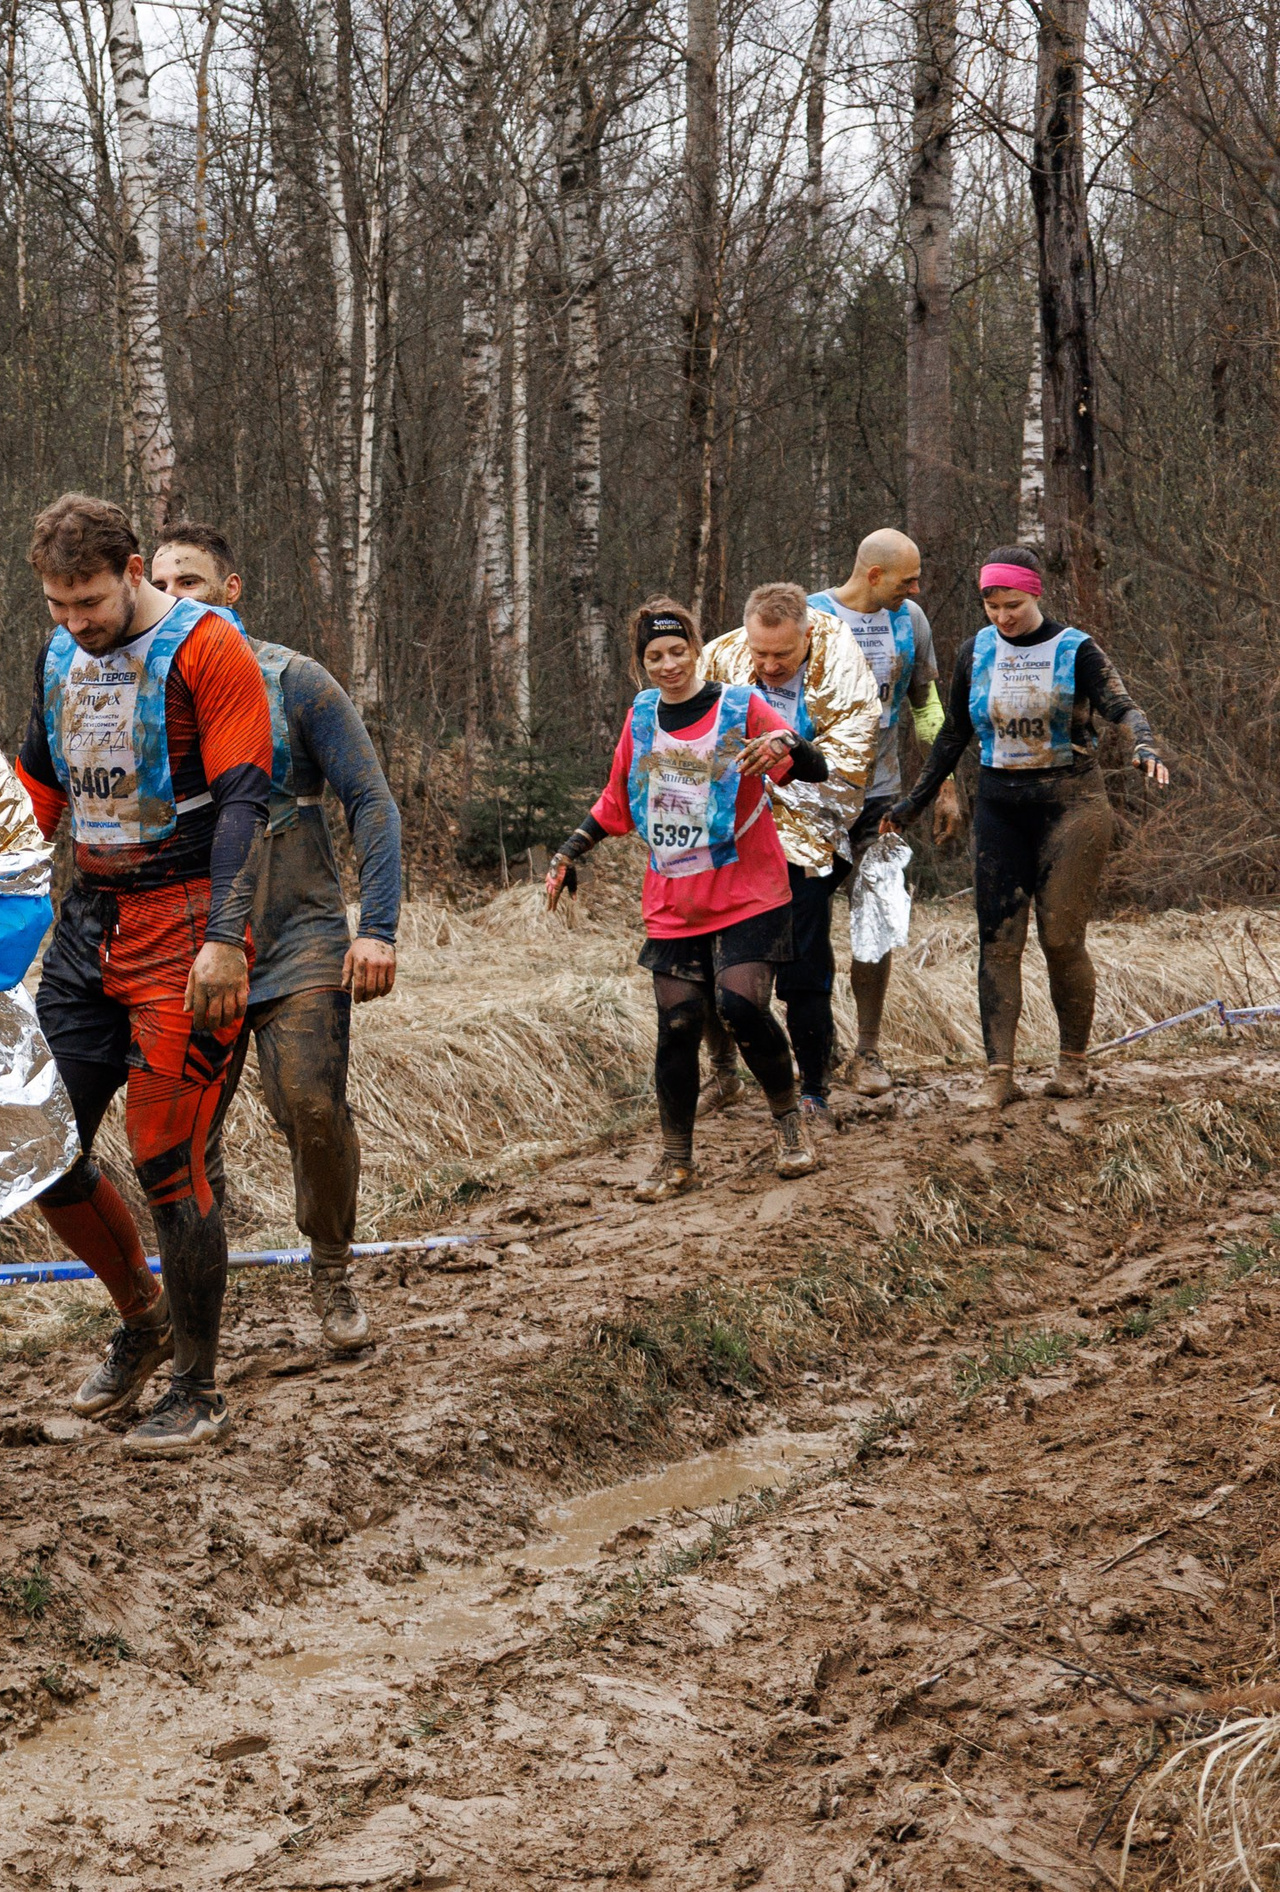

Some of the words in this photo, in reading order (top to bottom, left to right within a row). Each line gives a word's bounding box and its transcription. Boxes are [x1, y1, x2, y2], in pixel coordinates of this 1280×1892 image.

[857, 638, 884, 647] minex
[1022, 660, 1051, 668] ГЕРОЕВ
[101, 672, 137, 682] ГЕРОЕВ
[1002, 672, 1040, 681] Sminex
[76, 692, 121, 706] Smiex
[70, 766, 129, 799] 5402
[652, 823, 703, 849] 5397
